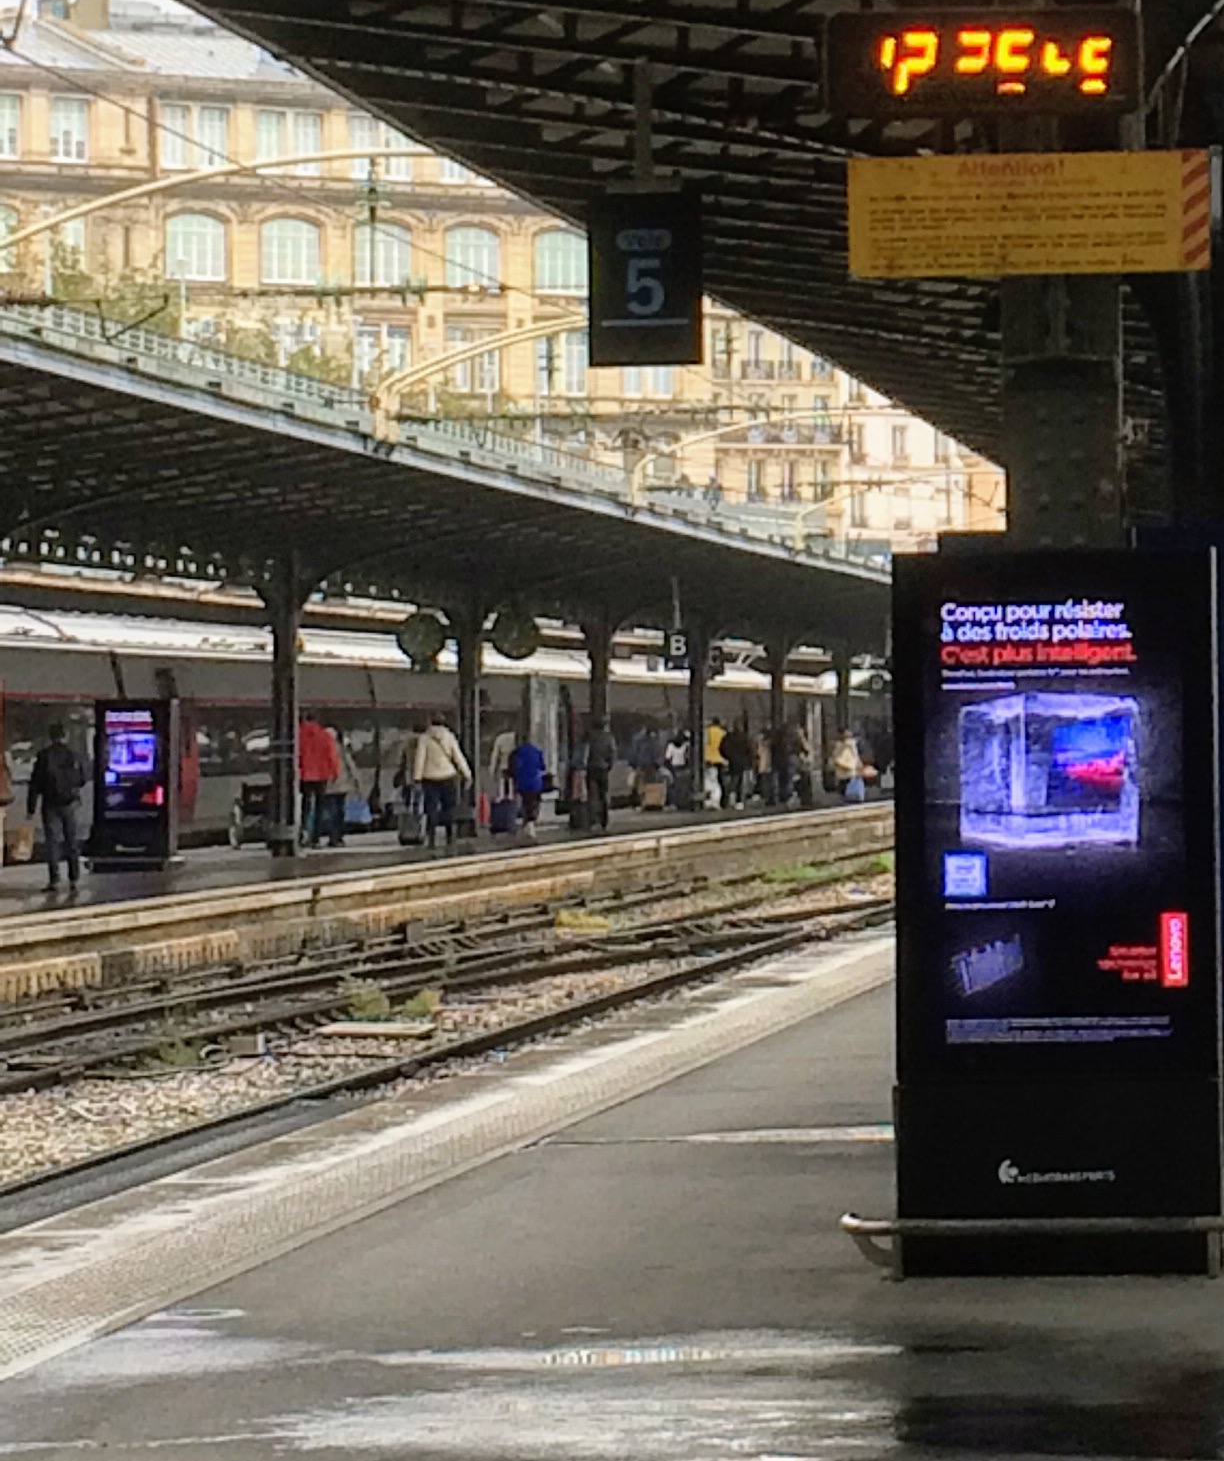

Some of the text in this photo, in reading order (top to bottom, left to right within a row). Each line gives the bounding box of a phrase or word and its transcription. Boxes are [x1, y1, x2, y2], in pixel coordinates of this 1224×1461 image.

[626, 258, 665, 316] 5
[941, 598, 1126, 624] Conçu pour résister
[941, 619, 1134, 643] à des froids polaires.
[669, 634, 687, 656] B
[941, 641, 1138, 665] C'est plus intelligent.
